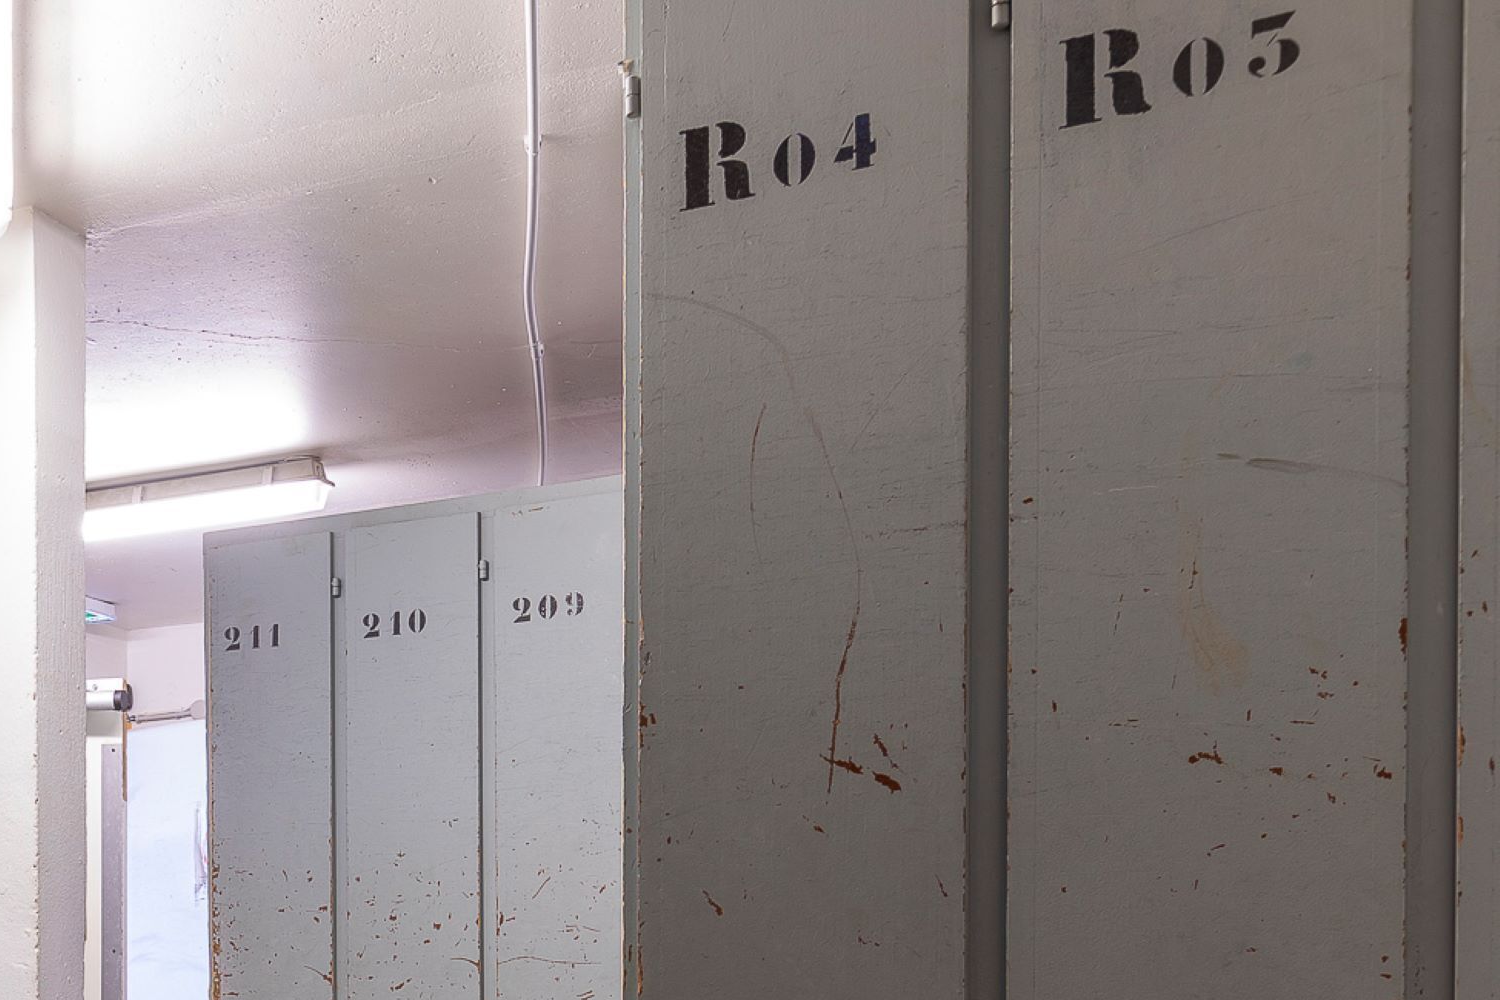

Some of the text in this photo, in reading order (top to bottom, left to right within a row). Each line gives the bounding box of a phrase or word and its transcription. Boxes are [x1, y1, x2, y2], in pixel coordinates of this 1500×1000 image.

[1059, 10, 1300, 130] R03
[679, 112, 878, 212] R04
[512, 591, 585, 623] 209
[224, 623, 280, 652] 211
[362, 608, 427, 639] 210
